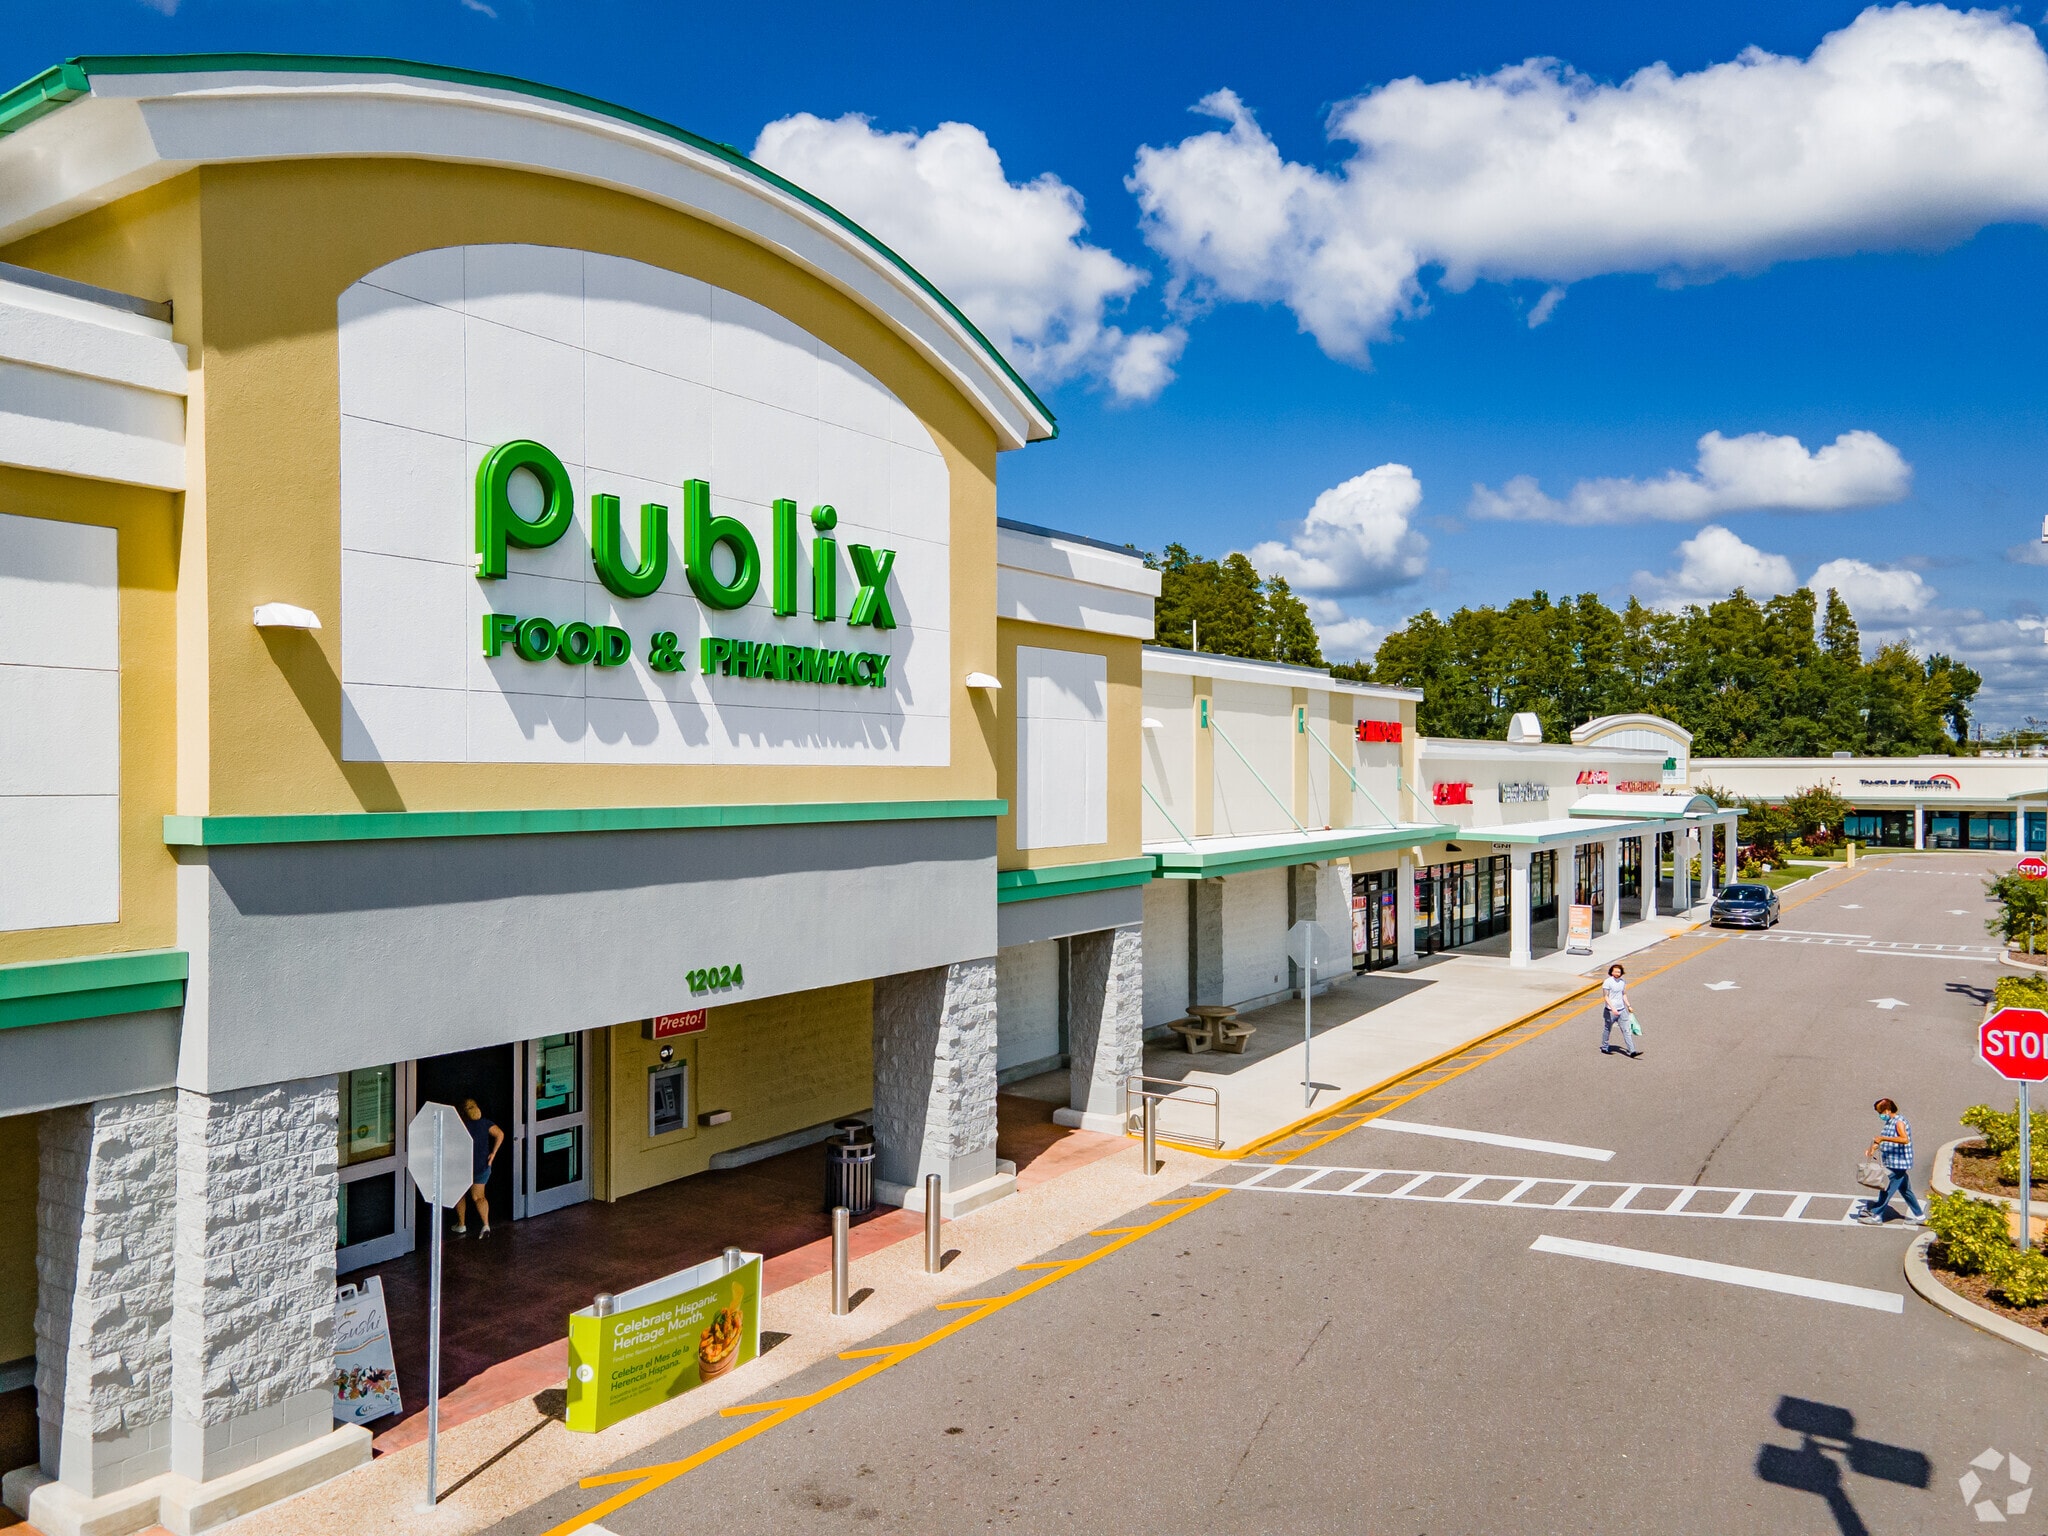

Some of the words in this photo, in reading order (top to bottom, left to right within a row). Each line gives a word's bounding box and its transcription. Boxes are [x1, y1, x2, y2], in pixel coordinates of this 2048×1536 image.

[475, 438, 897, 630] Publix
[482, 613, 632, 667] FOOD
[648, 631, 686, 672] &
[700, 637, 891, 688] PHARMACY
[2019, 864, 2047, 876] STOP
[685, 963, 744, 993] 12024
[659, 1010, 703, 1031] Presto!
[337, 1309, 381, 1344] Sushi
[613, 1327, 665, 1352] Heritage
[667, 1311, 705, 1333] Month.
[614, 1311, 672, 1337] Celebrate
[675, 1292, 718, 1317] Hispanic
[610, 1371, 647, 1391] Herencia
[648, 1360, 680, 1377] Hispana.
[611, 1365, 644, 1381] Celebra
[645, 1358, 653, 1368] el
[654, 1353, 671, 1364] Mes
[671, 1347, 682, 1358] de
[683, 1345, 690, 1353] la
